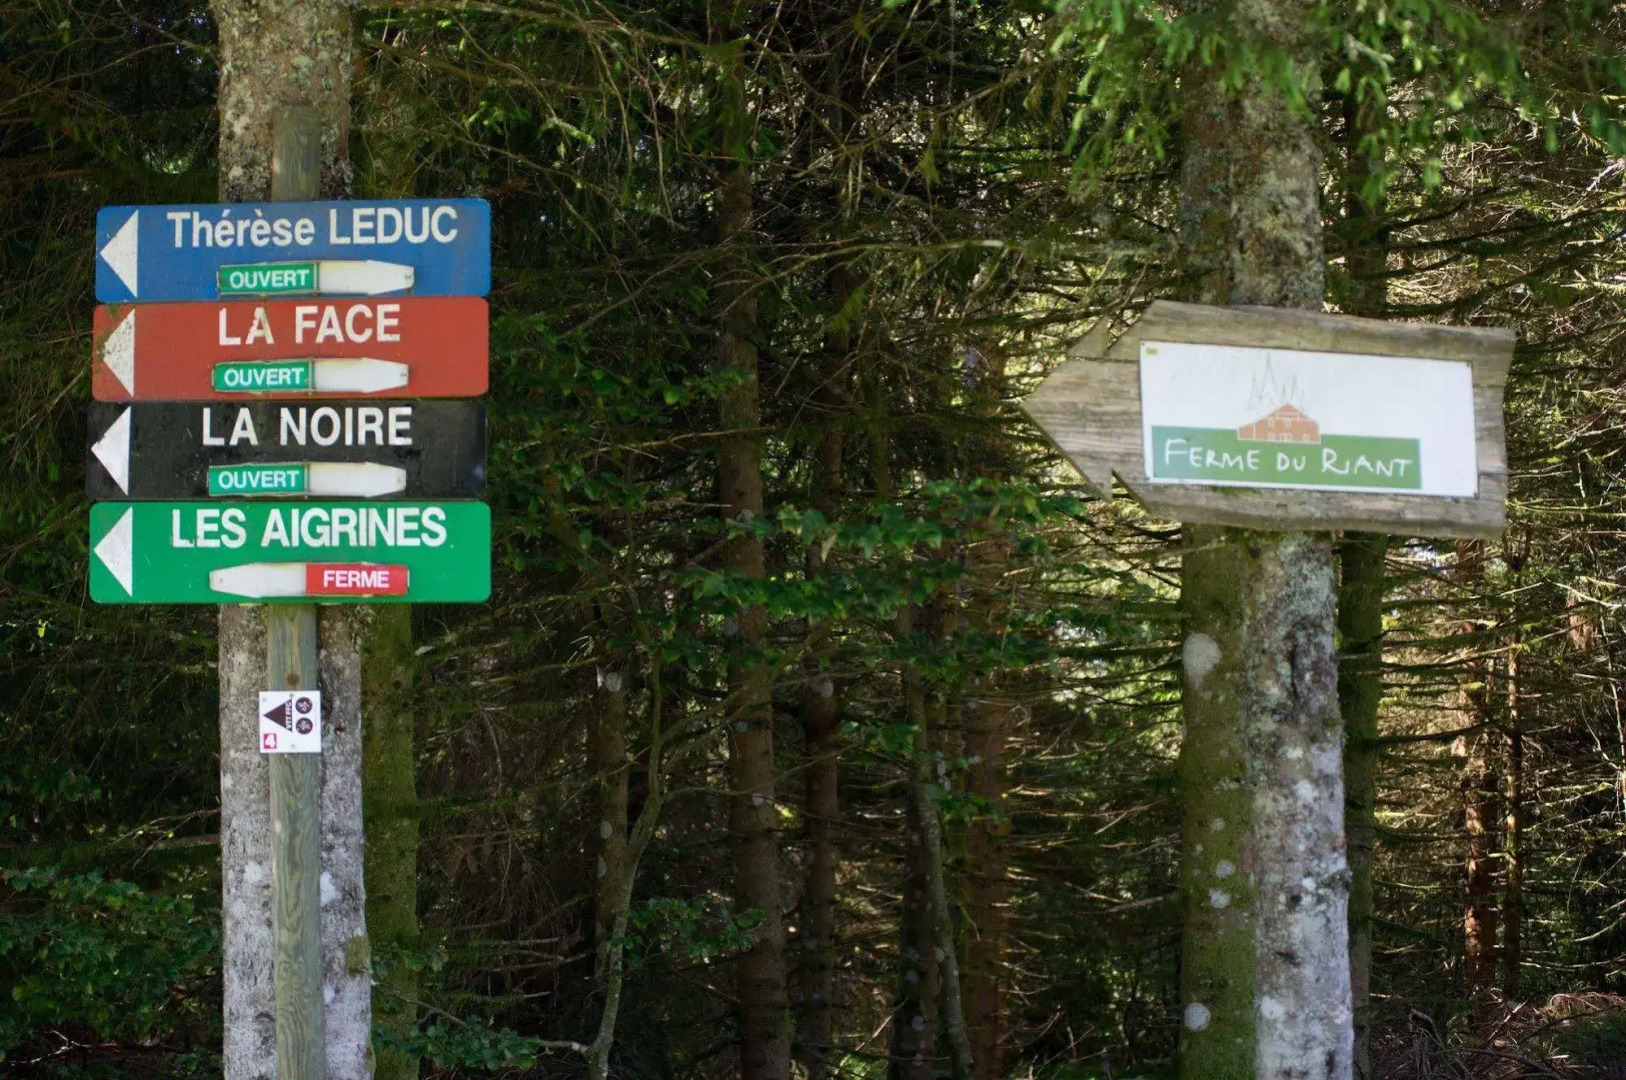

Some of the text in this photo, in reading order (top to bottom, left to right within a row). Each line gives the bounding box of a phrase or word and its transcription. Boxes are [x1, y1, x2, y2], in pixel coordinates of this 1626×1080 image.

[167, 205, 458, 248] Thérèse LEDUC
[229, 269, 309, 289] OUVERT
[218, 303, 400, 346] LA FACE
[224, 366, 304, 387] OUVERT
[202, 406, 413, 447] LA NOIRE
[1164, 438, 1260, 472] FERME
[1276, 452, 1306, 472] DU
[218, 469, 299, 489] OUVERT
[172, 506, 447, 549] LES AIGRINES
[323, 569, 390, 588] FERME
[264, 734, 275, 748] 4
